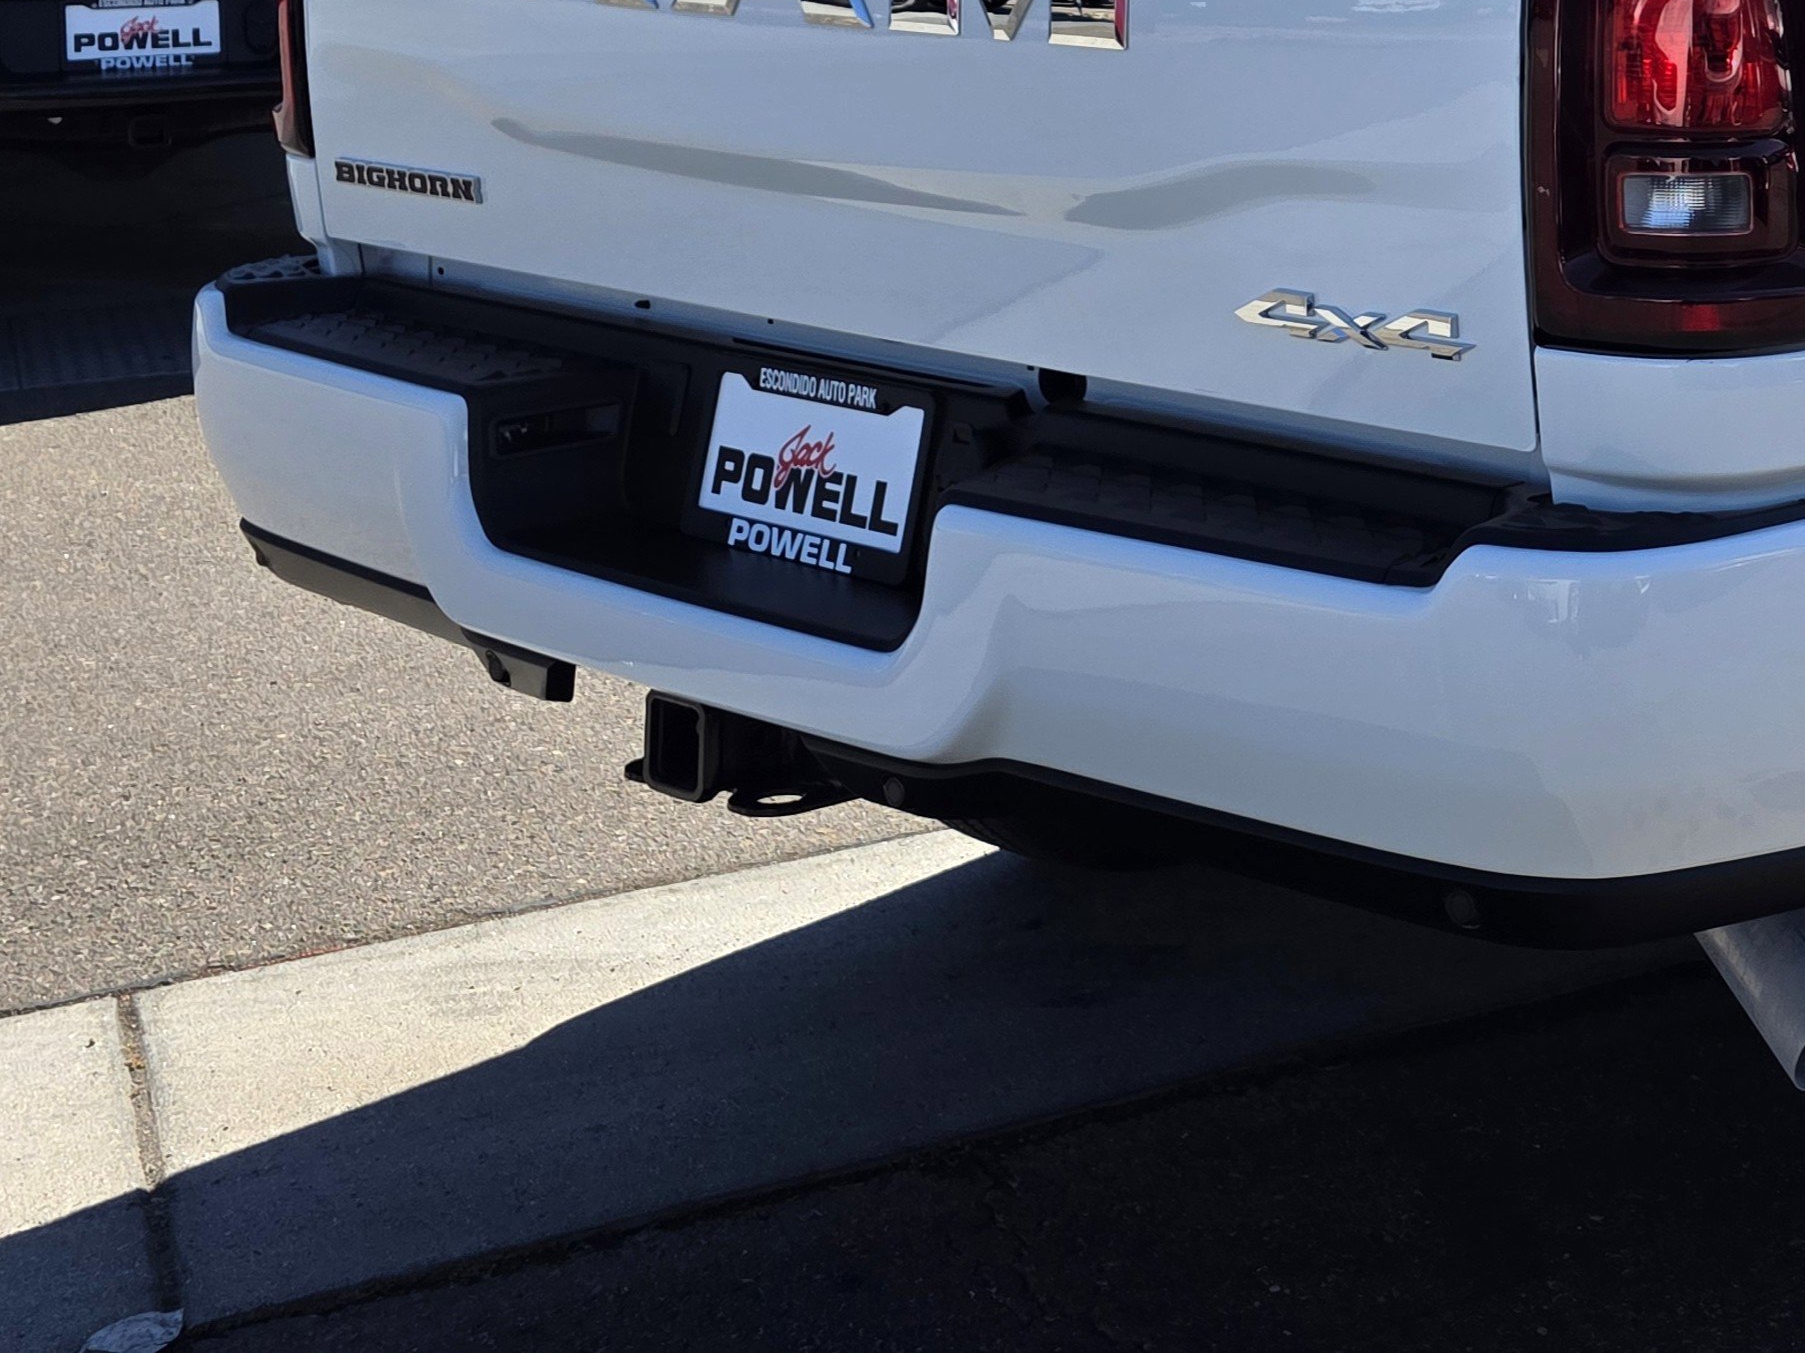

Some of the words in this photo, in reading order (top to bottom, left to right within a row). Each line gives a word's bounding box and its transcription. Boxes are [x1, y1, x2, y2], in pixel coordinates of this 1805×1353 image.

[74, 28, 212, 52] POWELL
[101, 54, 193, 70] POWELL
[334, 159, 477, 202] BIGHORN
[759, 367, 816, 397] ESCONDIDO
[818, 378, 847, 403] AUTO
[848, 384, 877, 409] PARK
[773, 424, 837, 488] Jack
[711, 446, 898, 537] POWELL
[727, 518, 852, 574] POWELL
